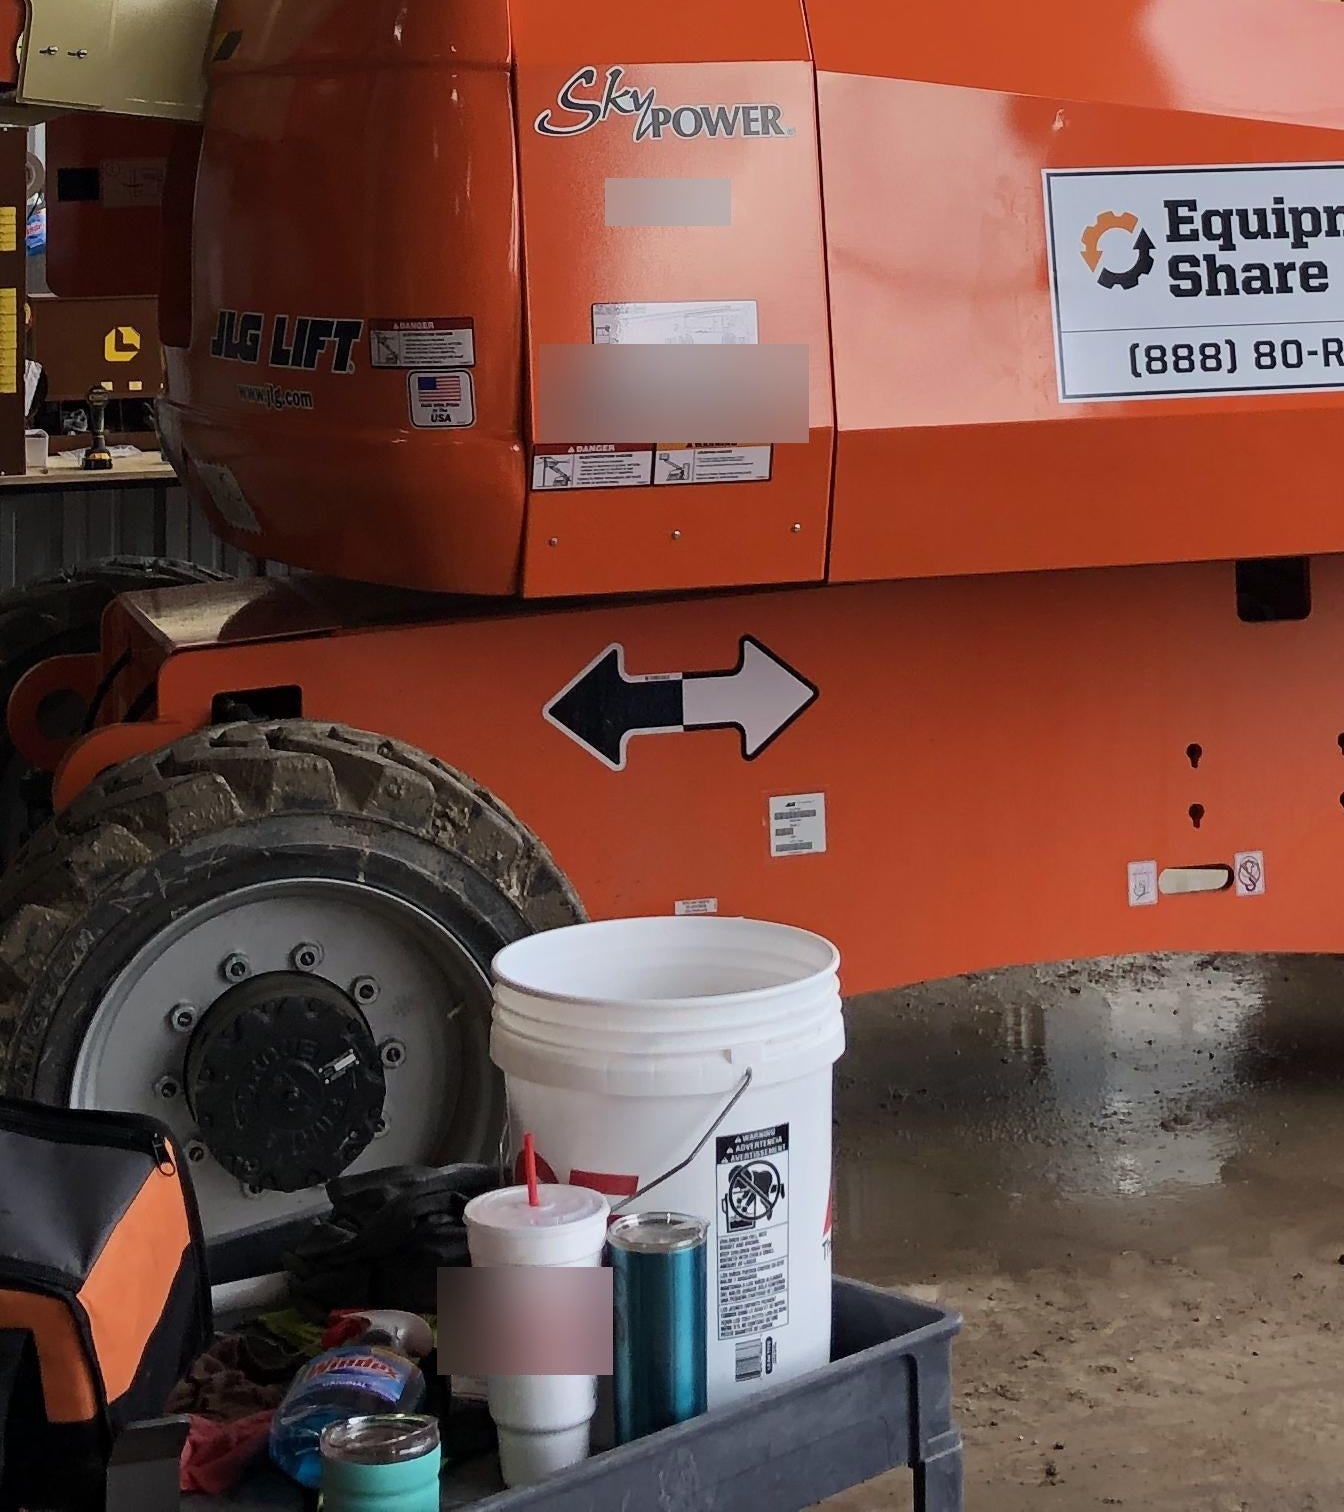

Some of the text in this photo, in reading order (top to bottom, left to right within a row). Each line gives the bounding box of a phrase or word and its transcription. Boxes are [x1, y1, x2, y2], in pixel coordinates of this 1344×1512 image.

[1167, 255, 1329, 298] Share
[209, 308, 265, 365] JLG
[268, 314, 364, 375] LIFT
[1129, 338, 1238, 378] (888)
[239, 383, 313, 410] www.jlg.com
[430, 413, 452, 423] USA
[576, 444, 616, 453] DANGER
[742, 1128, 776, 1142] WARNING
[306, 1355, 399, 1380] Windex
